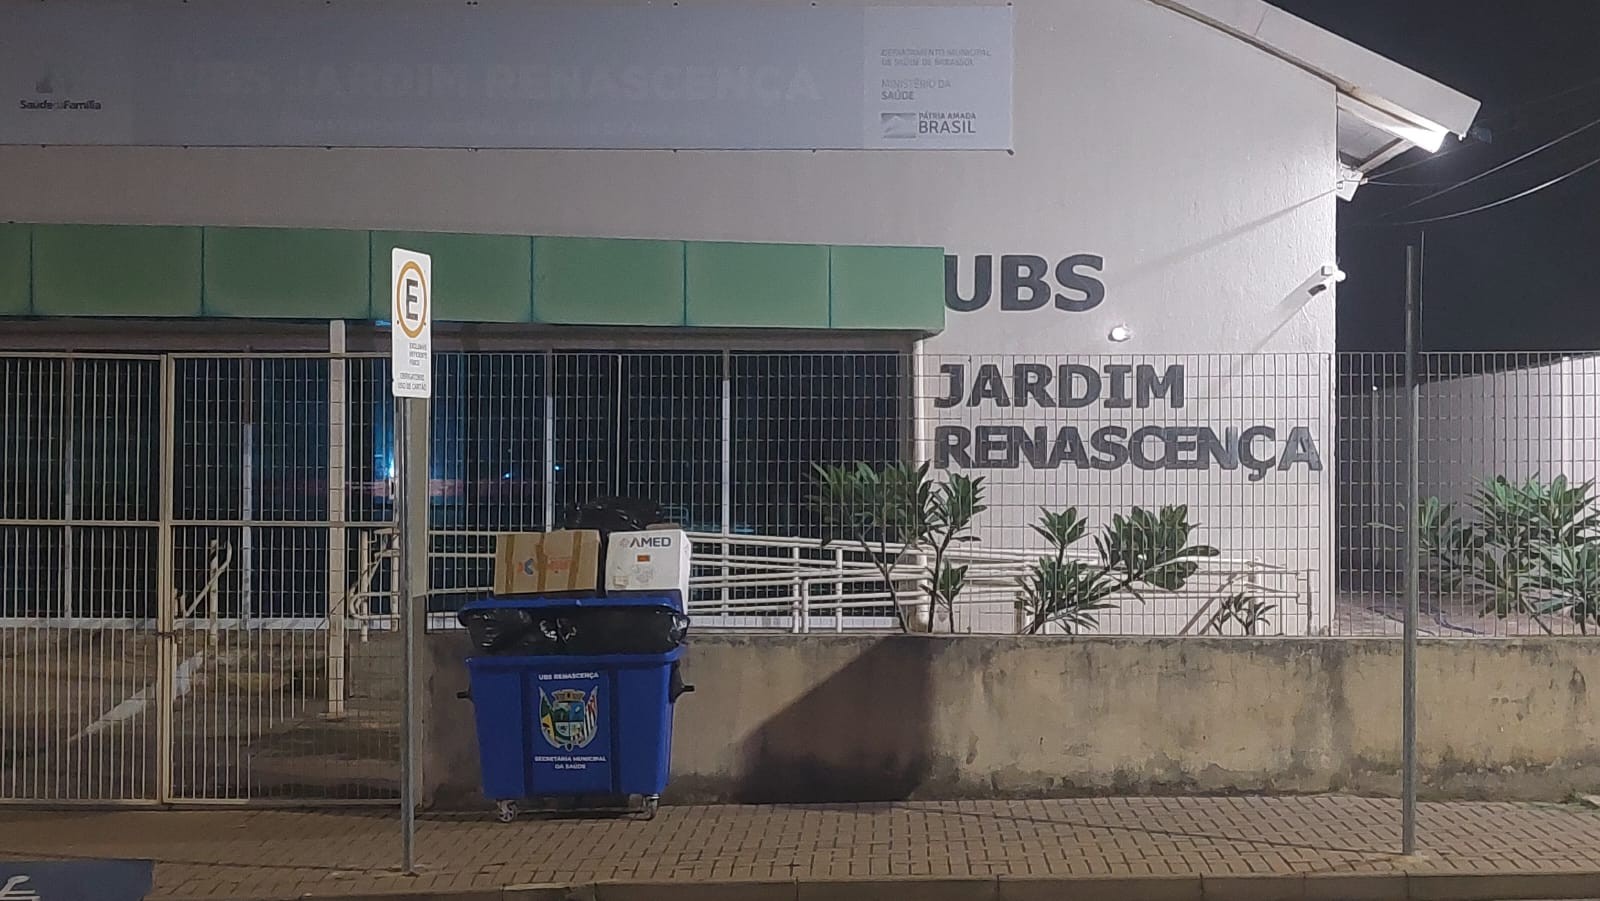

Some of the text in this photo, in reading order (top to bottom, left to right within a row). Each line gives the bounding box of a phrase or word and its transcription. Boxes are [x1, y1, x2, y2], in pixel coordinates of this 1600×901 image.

[881, 78, 951, 89] MINISTÉRIO DA
[881, 89, 915, 101] SAÚDE
[919, 110, 977, 120] PÁTRIA AMADA
[919, 120, 977, 134] BRASIL
[944, 254, 1105, 311] UBS
[406, 278, 418, 320] E
[934, 363, 1185, 409] JARDIM
[934, 425, 1323, 482] RENASCENÇA
[629, 536, 672, 548] AMED
[553, 671, 599, 681] RENASCENÇA
